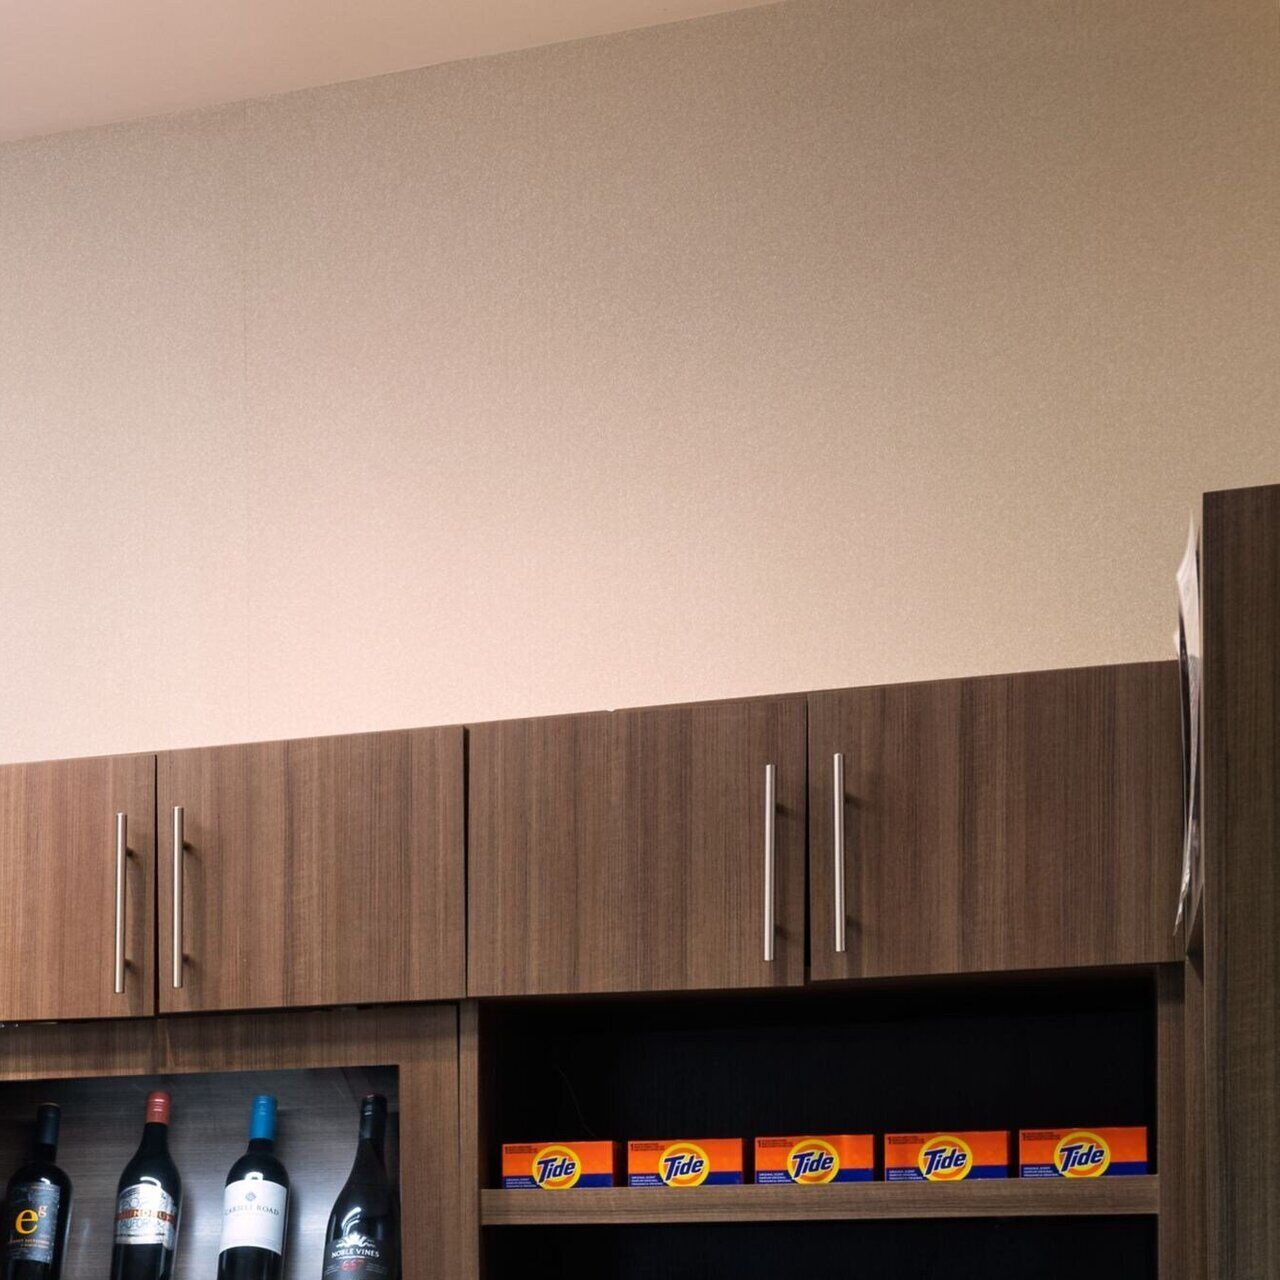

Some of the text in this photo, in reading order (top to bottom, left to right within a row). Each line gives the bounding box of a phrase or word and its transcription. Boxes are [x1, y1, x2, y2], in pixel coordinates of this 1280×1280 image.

[537, 1157, 576, 1184] Tide
[664, 1155, 703, 1181] Tide
[793, 1152, 834, 1179] Tide
[923, 1148, 967, 1177] Tide
[1059, 1144, 1104, 1172] Tide
[256, 1204, 281, 1217] ROAD
[331, 1248, 380, 1259] NOBLE VINES
